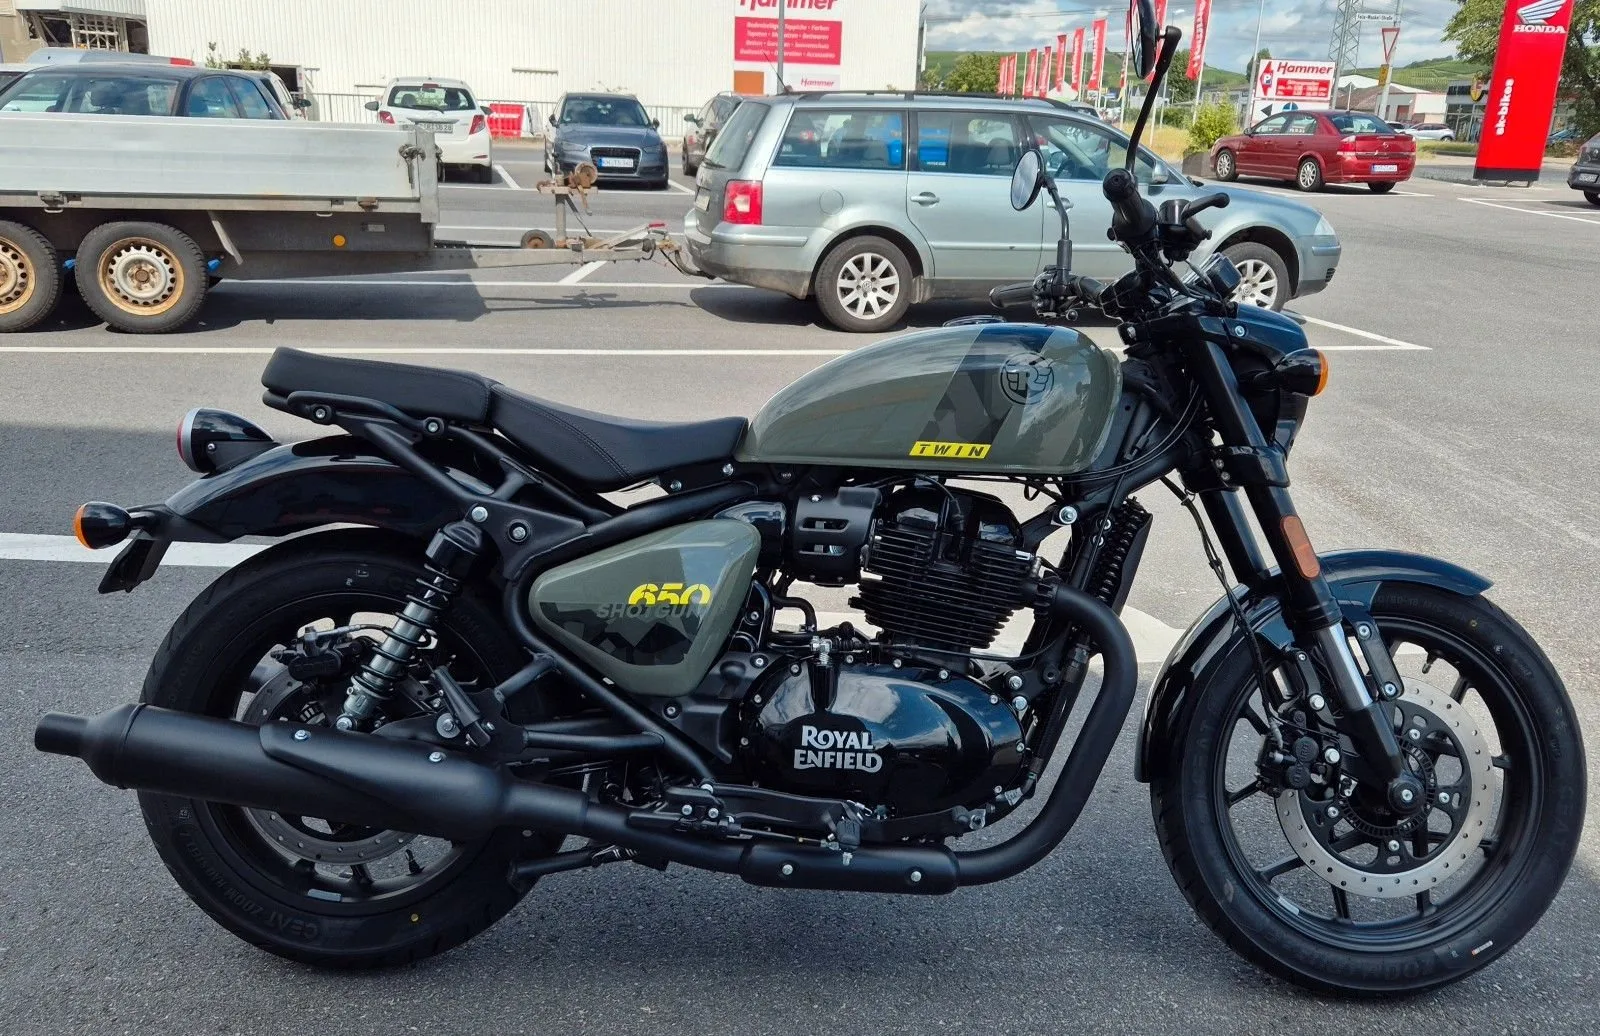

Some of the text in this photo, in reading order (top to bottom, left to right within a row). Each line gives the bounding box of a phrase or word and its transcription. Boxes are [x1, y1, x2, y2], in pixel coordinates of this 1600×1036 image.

[1513, 24, 1567, 33] HONDA
[1277, 62, 1333, 74] Hammer
[801, 78, 834, 87] Hammer
[1495, 79, 1514, 135] sk-bikes
[919, 443, 984, 457] TWIN
[628, 583, 711, 605] 650
[801, 725, 874, 749] ROYAL
[794, 749, 883, 773] ENFIELD
